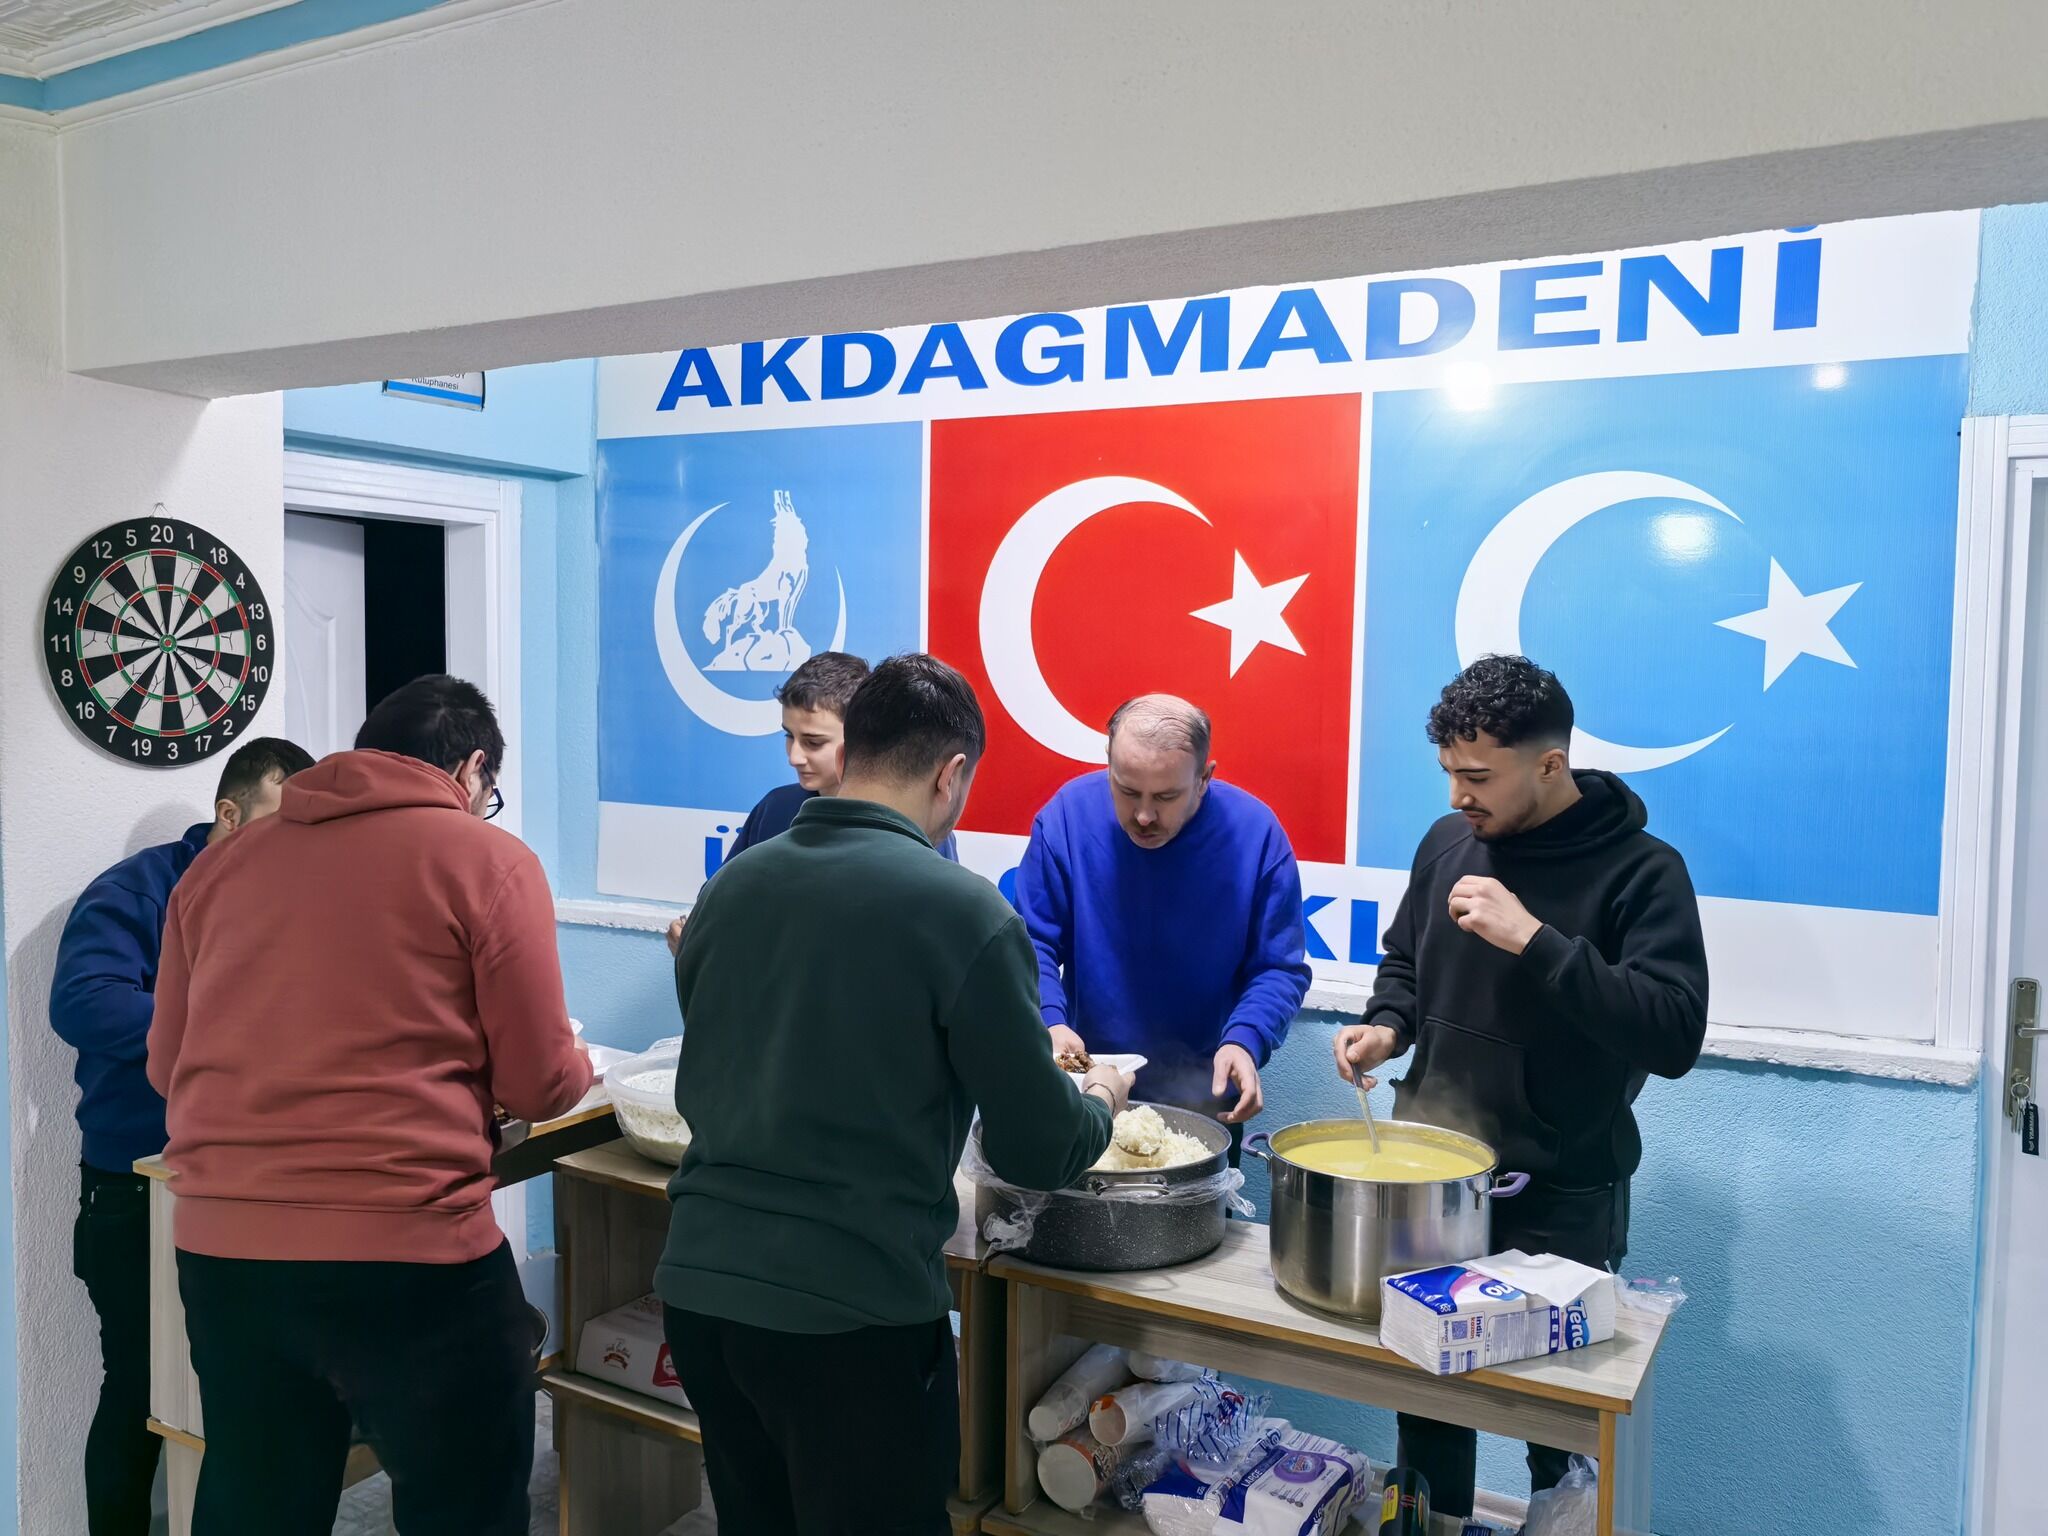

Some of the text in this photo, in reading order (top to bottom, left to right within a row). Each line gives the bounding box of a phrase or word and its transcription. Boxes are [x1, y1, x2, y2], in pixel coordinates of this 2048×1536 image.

[127, 530, 136, 546] 5
[151, 525, 173, 543] 20
[187, 533, 194, 549] 1
[92, 541, 112, 558] 12
[210, 547, 229, 565] 18
[74, 567, 85, 583] 9
[236, 573, 245, 589] 4
[54, 598, 73, 615] 14
[249, 604, 264, 619] 13
[52, 635, 69, 652] 11
[257, 635, 266, 650] 6
[62, 669, 73, 686] 8
[252, 666, 268, 682] 10
[76, 702, 95, 719] 16
[240, 695, 255, 711] 15
[106, 726, 117, 743] 7
[223, 719, 233, 735] 2
[132, 739, 151, 756] 19
[168, 743, 178, 759] 3
[195, 735, 211, 752] 17
